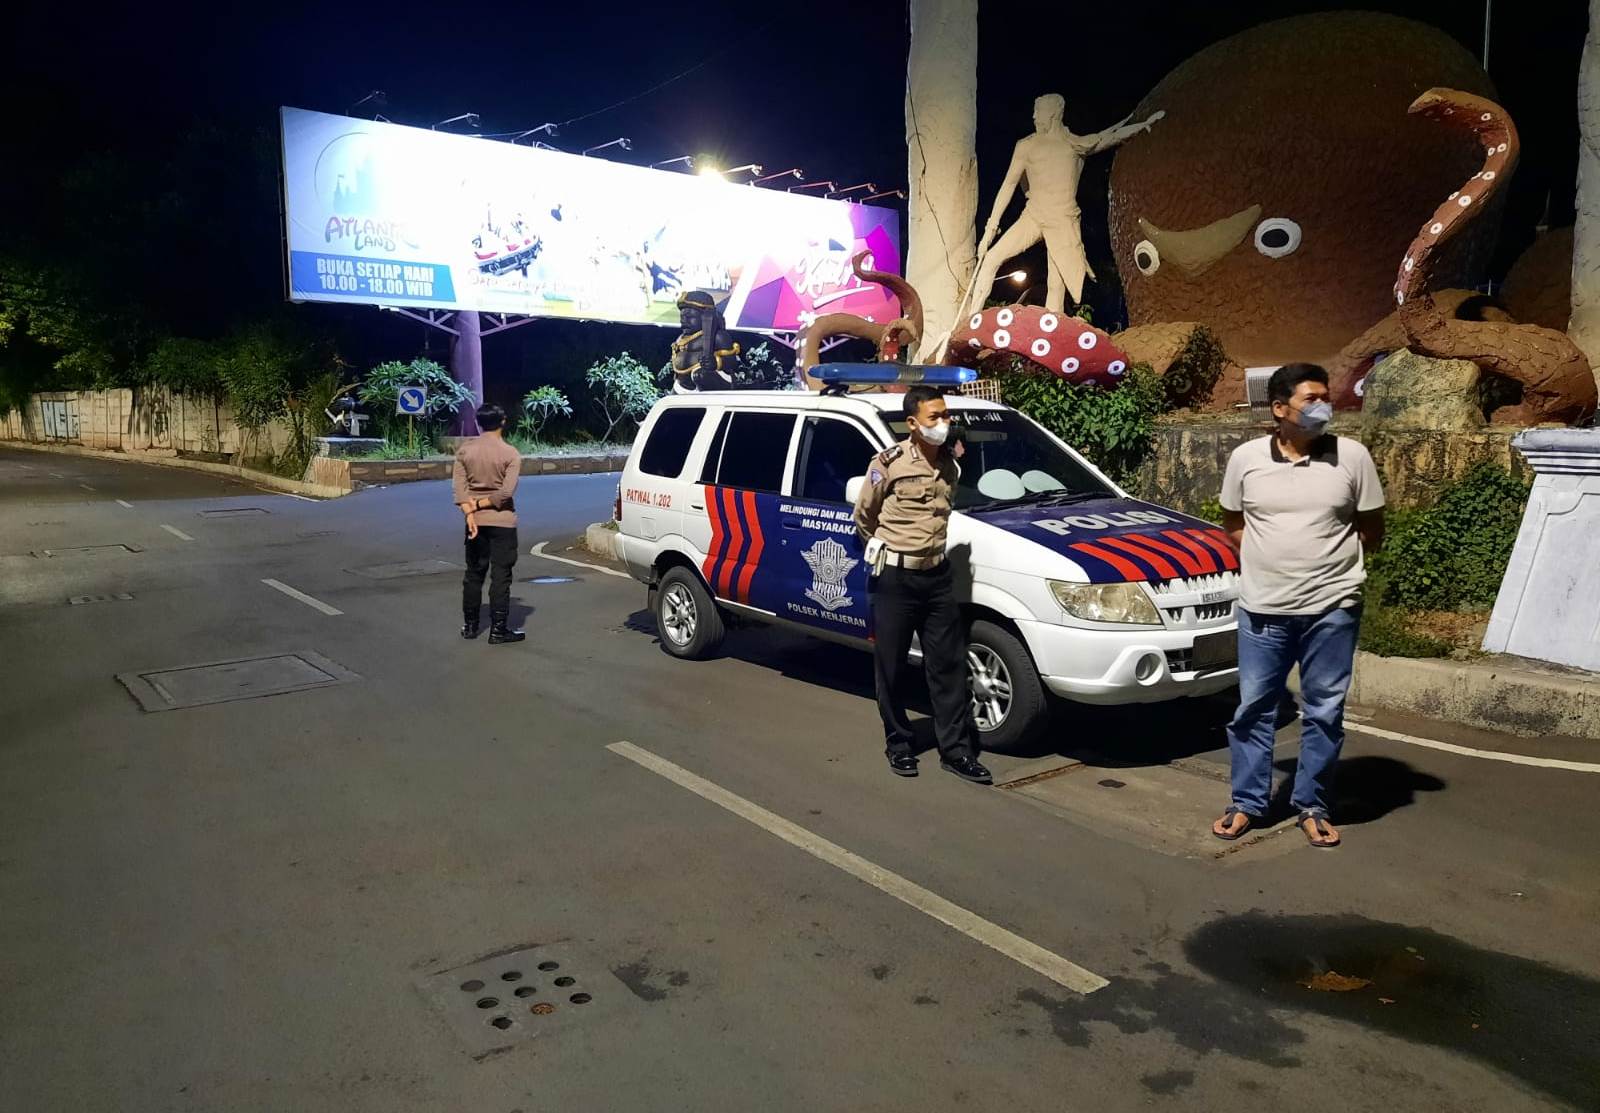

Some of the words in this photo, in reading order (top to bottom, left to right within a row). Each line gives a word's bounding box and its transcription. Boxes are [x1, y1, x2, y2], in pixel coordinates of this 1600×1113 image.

[325, 216, 420, 250] ATLANT
[354, 234, 397, 252] LAND
[316, 258, 354, 276] BUKA
[356, 261, 402, 280] SETIAP
[403, 265, 434, 283] HARI
[319, 274, 358, 292] 10.00
[367, 277, 404, 296] 18.00
[405, 280, 433, 297] WIB
[626, 488, 651, 505] PATWAL
[653, 493, 672, 508] 1.202
[779, 503, 820, 517] MELINDUNGI
[820, 509, 835, 519] DAN
[835, 511, 855, 522] MELA
[1030, 510, 1184, 536] POLISI
[801, 518, 857, 535] MASYARAKA
[1202, 591, 1229, 603] ISUZ
[787, 602, 819, 617] POLSEK
[820, 610, 867, 628] KENJERAN
